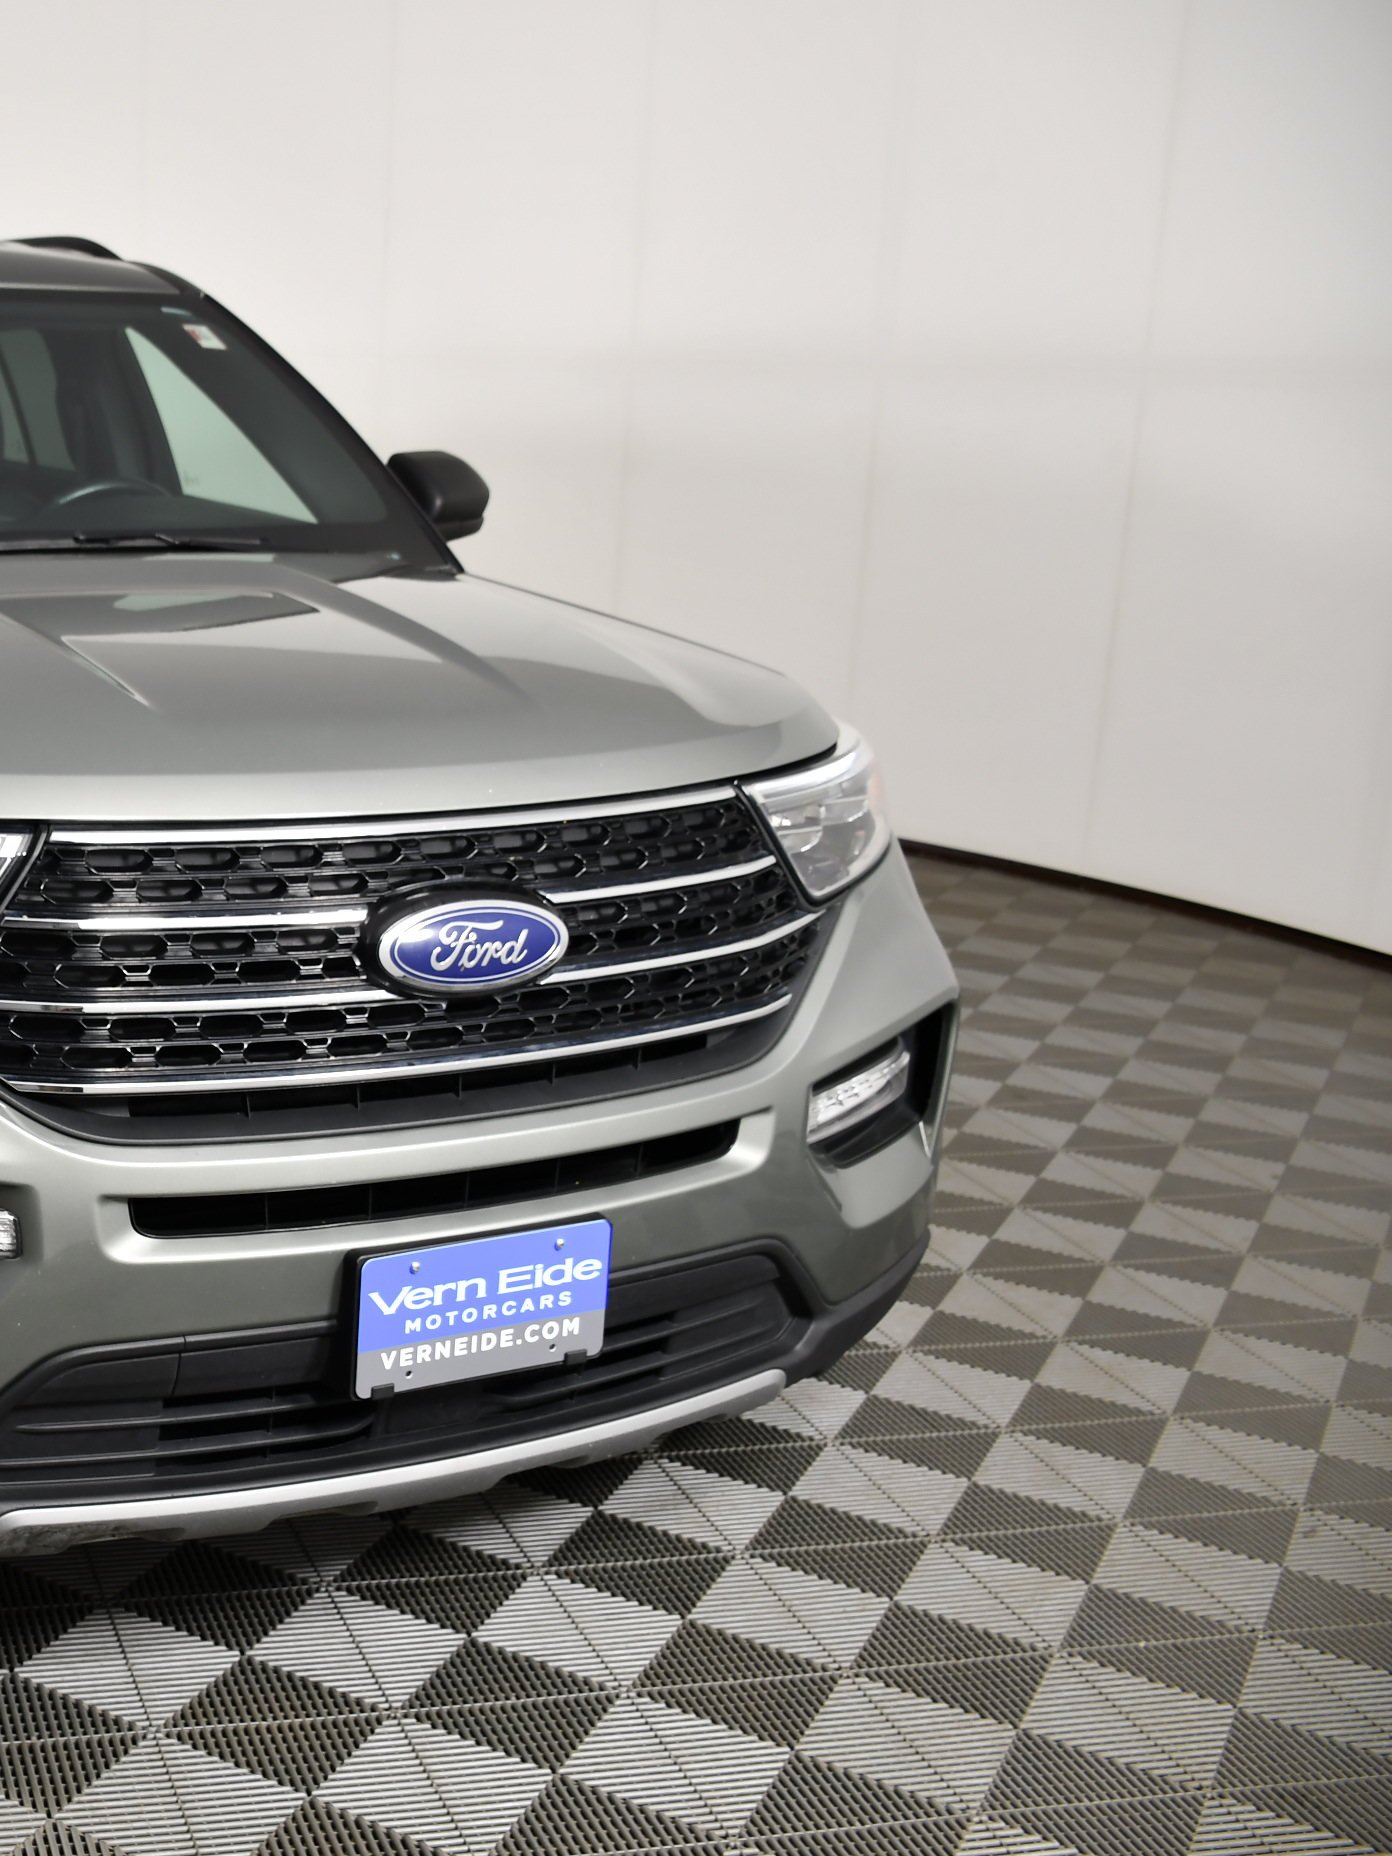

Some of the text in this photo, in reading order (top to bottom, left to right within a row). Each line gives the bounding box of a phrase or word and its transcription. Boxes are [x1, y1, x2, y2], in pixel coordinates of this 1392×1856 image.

[430, 919, 529, 972] Ford
[368, 1257, 603, 1316] Vern Eide
[404, 1291, 573, 1334] MOTORCARS
[380, 1316, 581, 1370] VERNEIDE.COM
